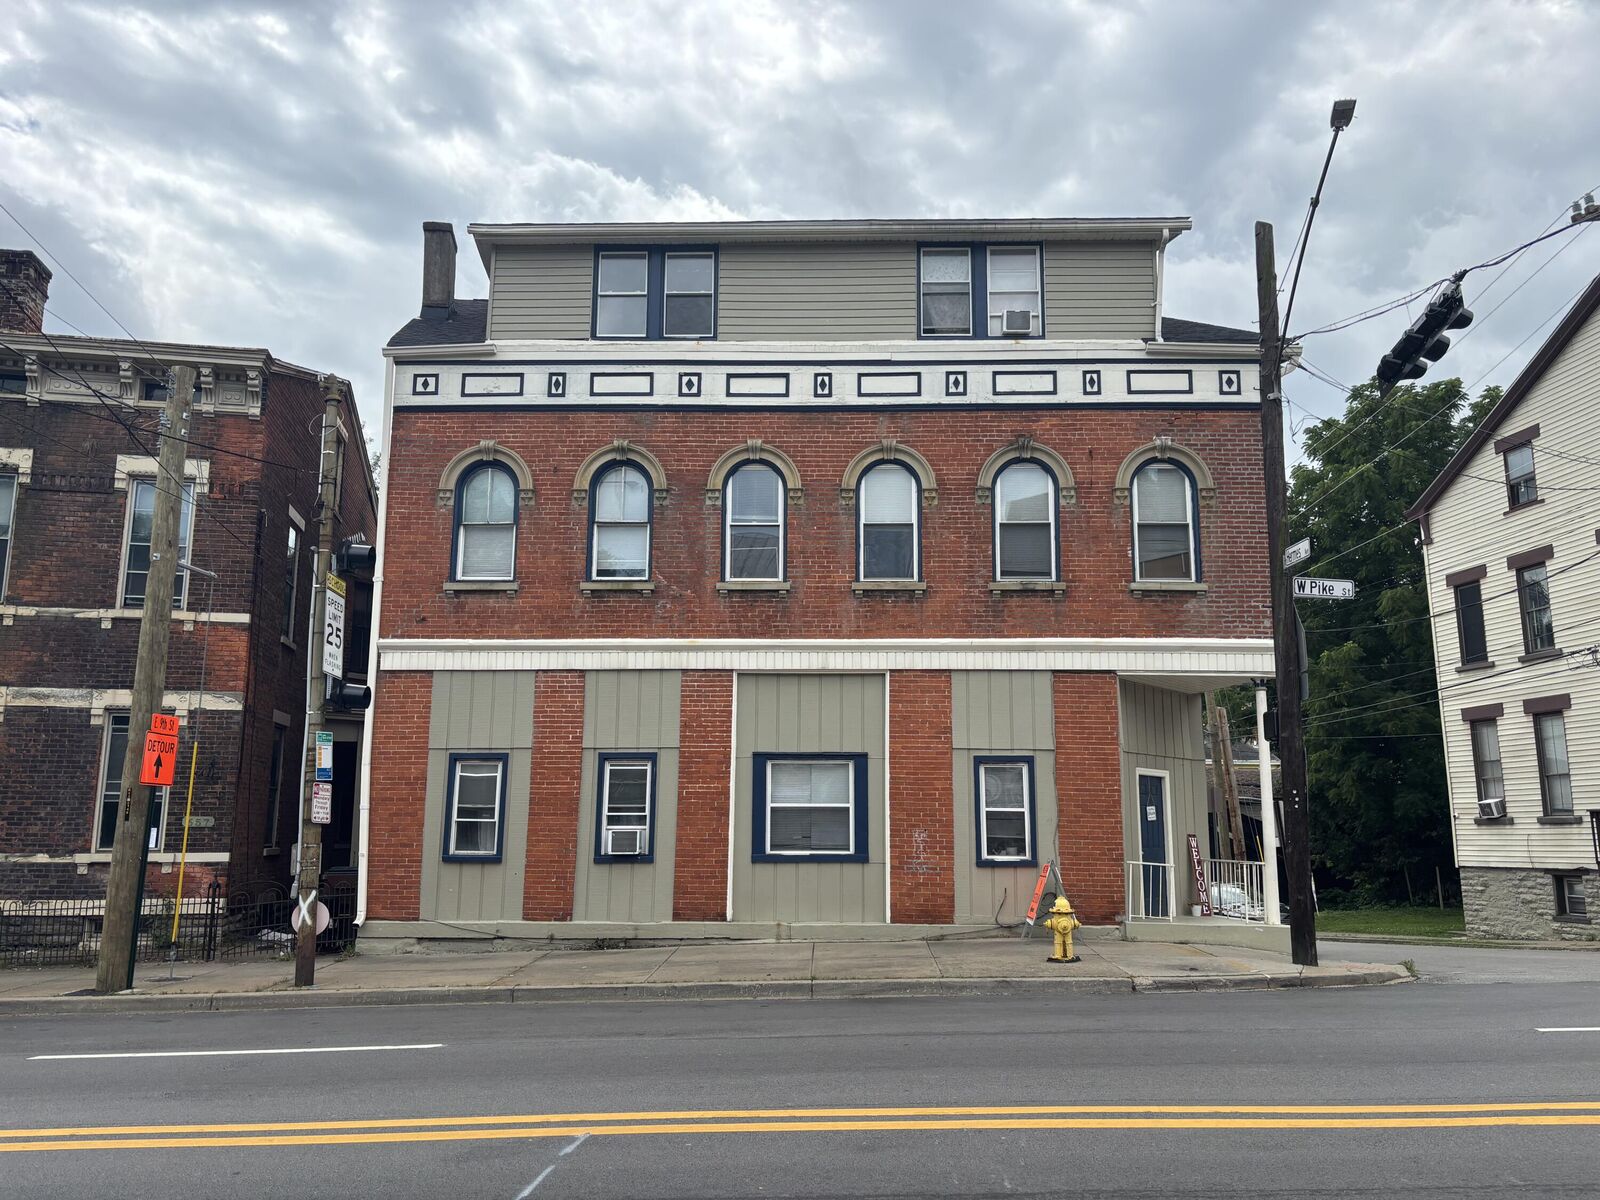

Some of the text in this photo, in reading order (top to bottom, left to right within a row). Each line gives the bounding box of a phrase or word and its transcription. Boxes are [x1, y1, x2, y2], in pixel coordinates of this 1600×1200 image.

[327, 574, 346, 595] SCHOOL
[1297, 580, 1351, 596] W Pike St
[327, 596, 344, 614] SPEED
[328, 609, 342, 625] LIMIT
[326, 622, 342, 650] 25
[328, 651, 339, 661] WHEN
[324, 658, 342, 671] FLASHING
[147, 739, 175, 755] DETOUR
[1189, 837, 1210, 914] WELCOME
